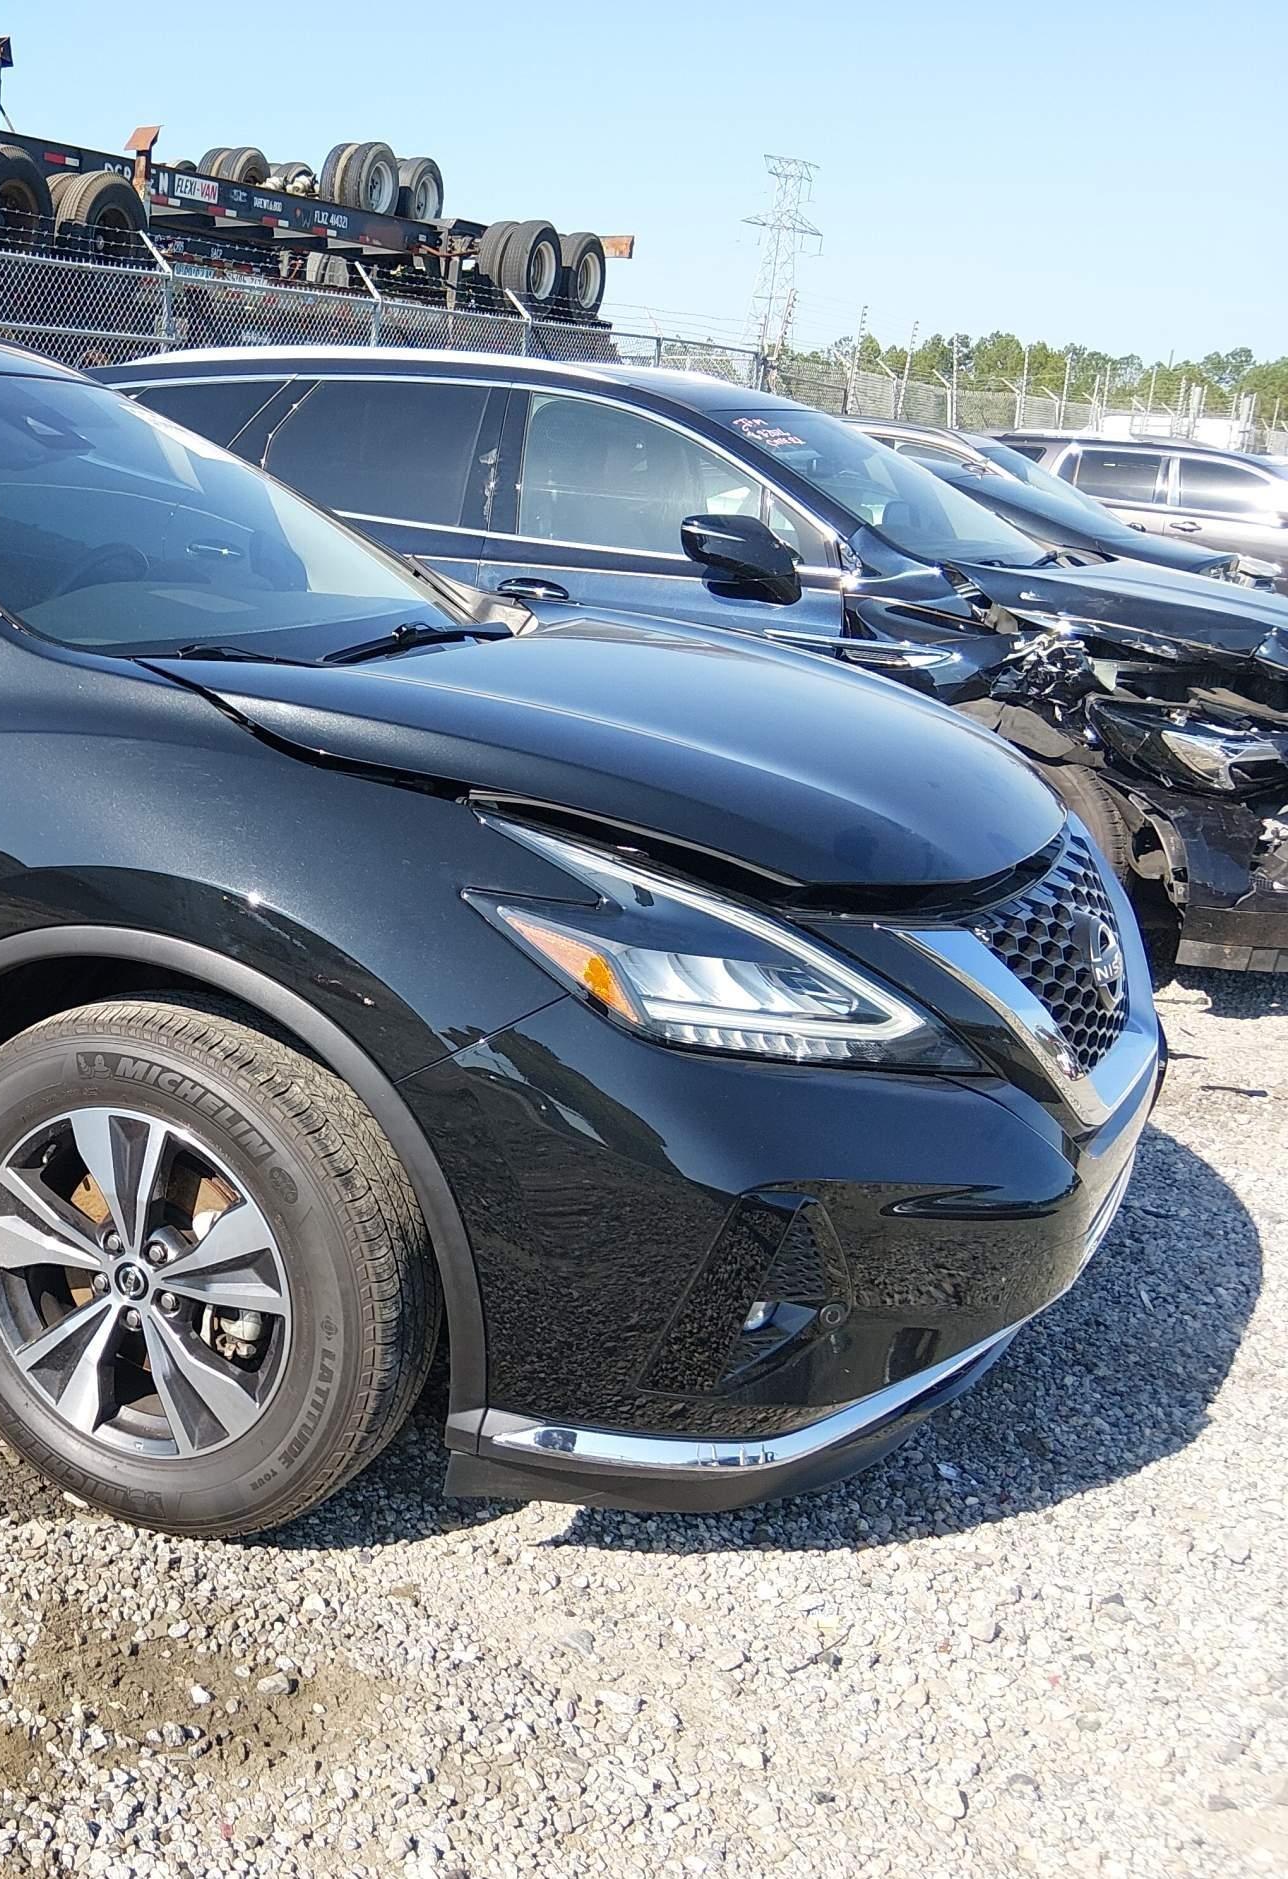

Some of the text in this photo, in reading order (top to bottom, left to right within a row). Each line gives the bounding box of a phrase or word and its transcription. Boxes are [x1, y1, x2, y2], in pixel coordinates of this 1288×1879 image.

[175, 177, 217, 202] FLEXI-VAN
[314, 210, 348, 229] FLXZ 414321
[115, 1056, 274, 1162] MICHELIN
[249, 1347, 337, 1492] LATITUDE TOUR
